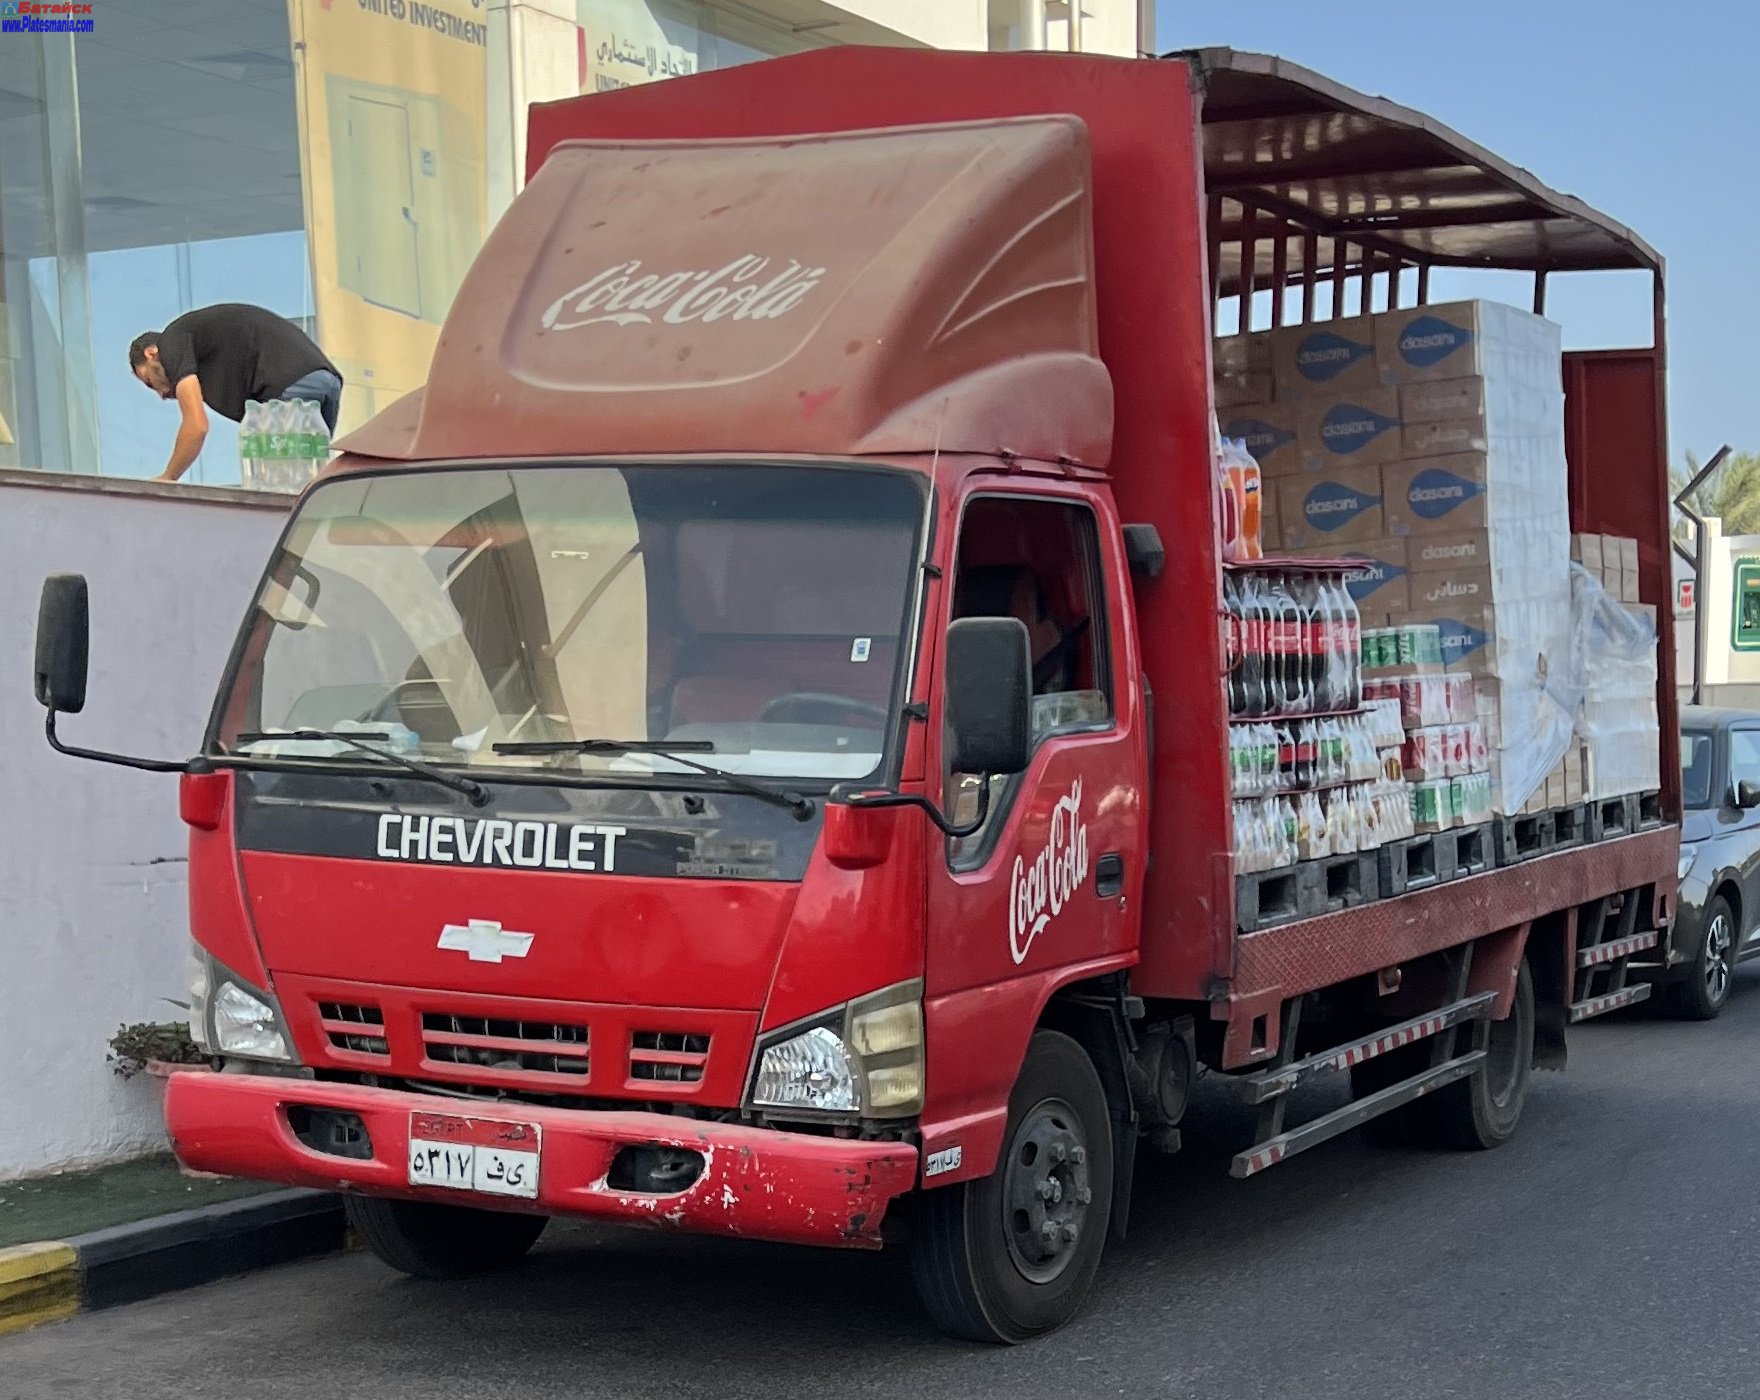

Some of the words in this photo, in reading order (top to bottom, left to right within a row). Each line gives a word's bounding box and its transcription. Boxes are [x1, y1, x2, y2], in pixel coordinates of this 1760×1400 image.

[409, 1, 487, 47] INVESTMENT
[541, 254, 826, 330] Coca-Cola
[1402, 333, 1455, 349] dasani
[1306, 498, 1357, 514] dasani
[1409, 486, 1463, 501] dasani
[1422, 544, 1477, 559] dasani
[377, 814, 627, 872] CHEVROLET
[1009, 773, 1089, 965] Coca-Cola
[413, 1148, 471, 1179] ٥٣١٧
